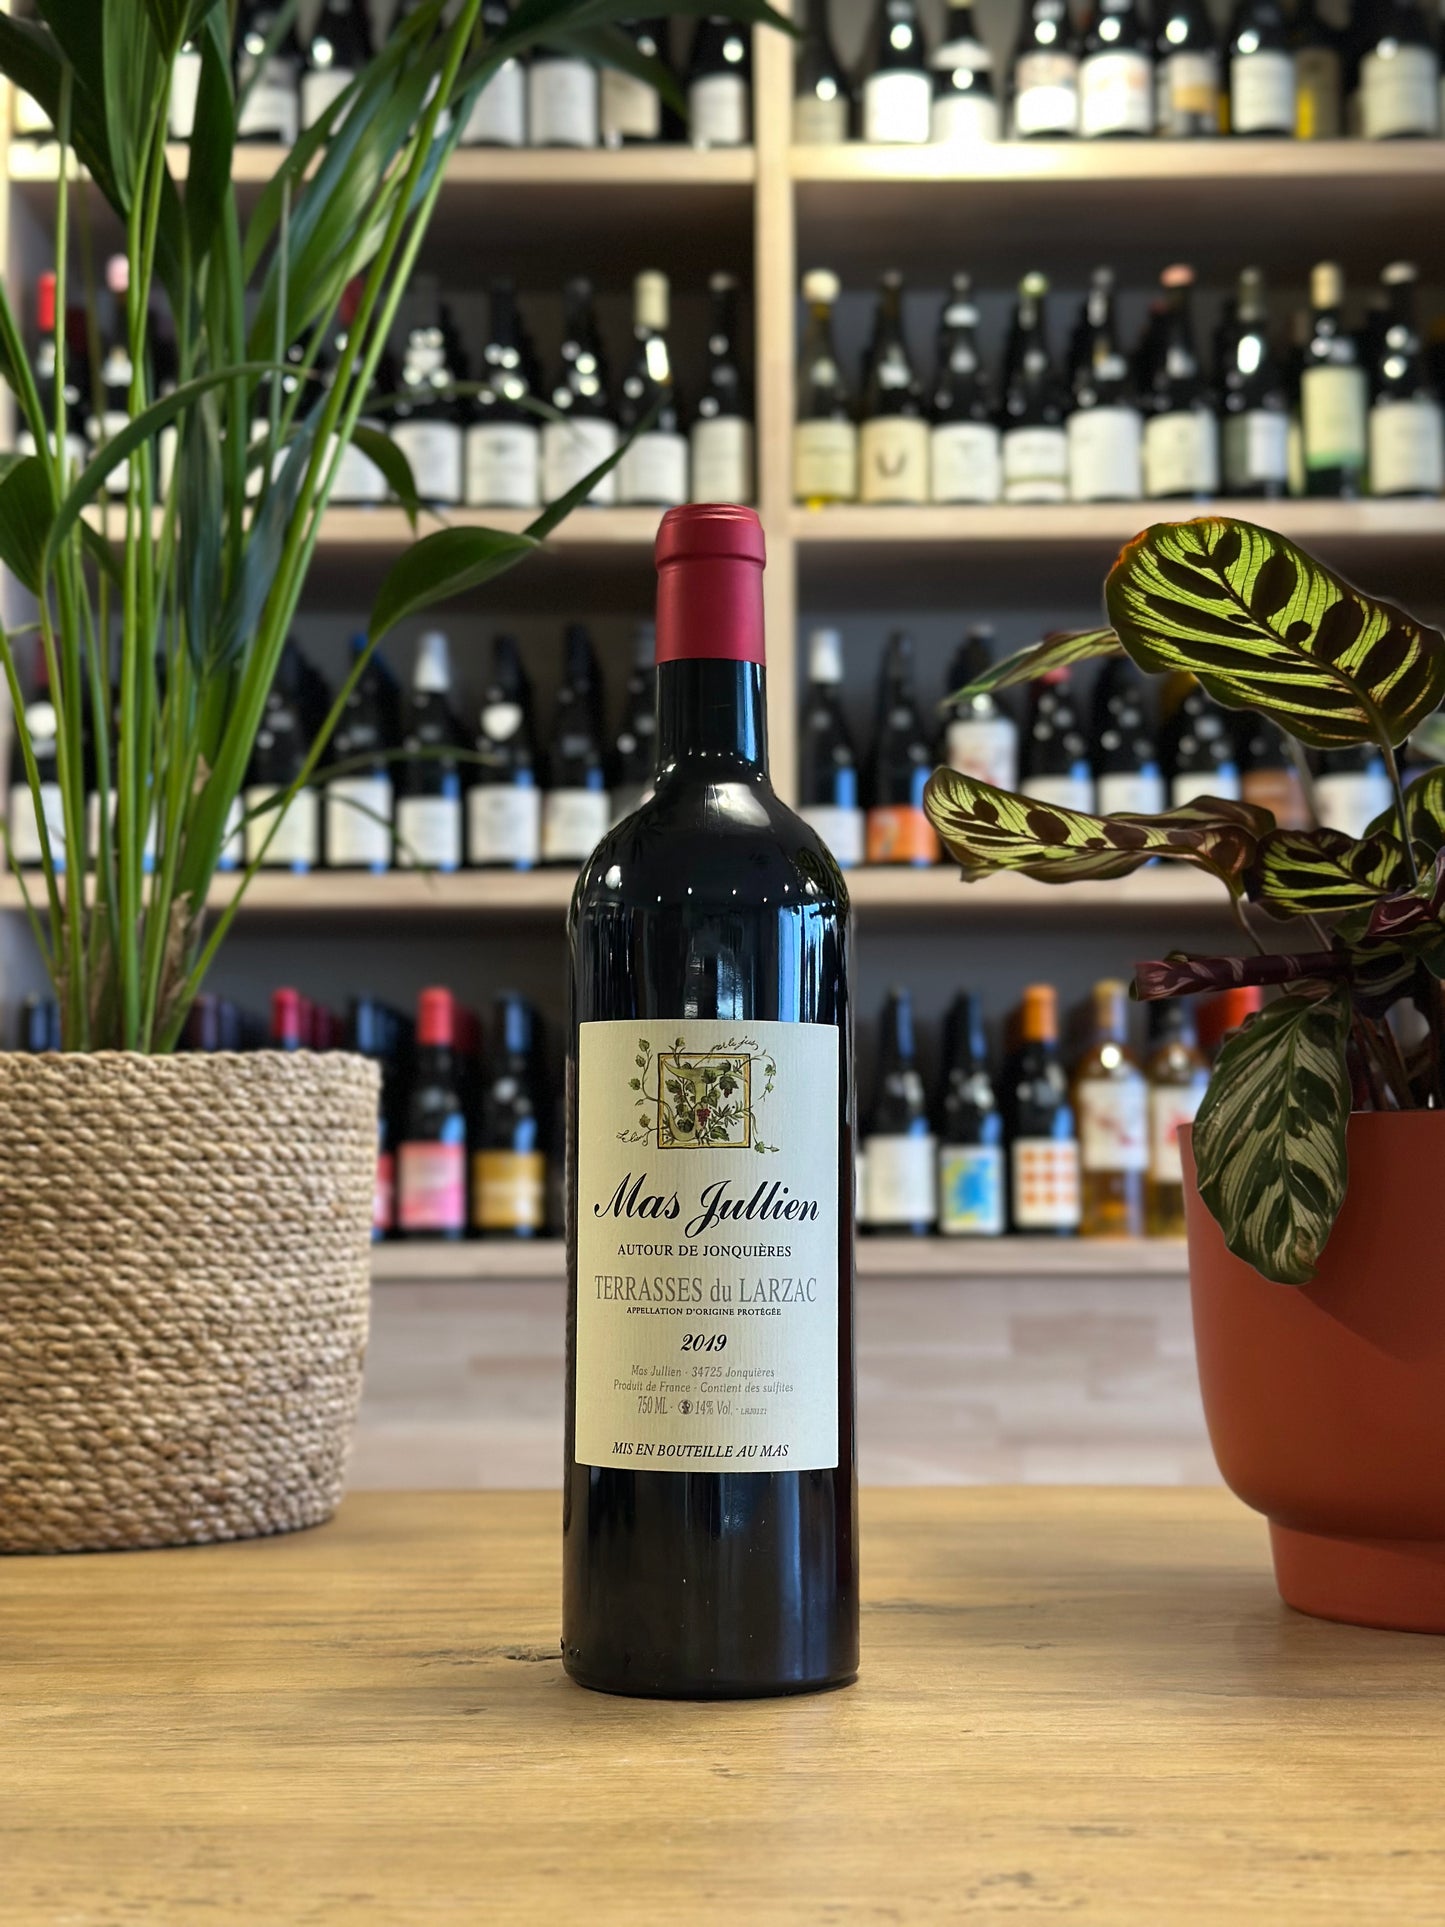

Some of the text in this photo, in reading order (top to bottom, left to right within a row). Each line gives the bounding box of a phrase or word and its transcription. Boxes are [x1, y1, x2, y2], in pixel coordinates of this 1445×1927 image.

[593, 1172, 820, 1239] Mas Jullien
[617, 1243, 792, 1260] AUTOUR DE JONQUIÈRES
[594, 1275, 818, 1303] TERRASSES du LARZAC
[626, 1306, 783, 1317] APPELLATION D'ORIGINE PROTÉGÉE
[680, 1333, 728, 1352] 2019
[631, 1364, 775, 1380] Mas Jullien 34725 Jonquières
[613, 1378, 794, 1395] Produit de France Contient des sulfites
[637, 1395, 653, 1414] 750
[654, 1396, 668, 1415] ML
[695, 1400, 714, 1415] 14%
[612, 1441, 790, 1458] MIS EN BOUTEILLE AU MAS
